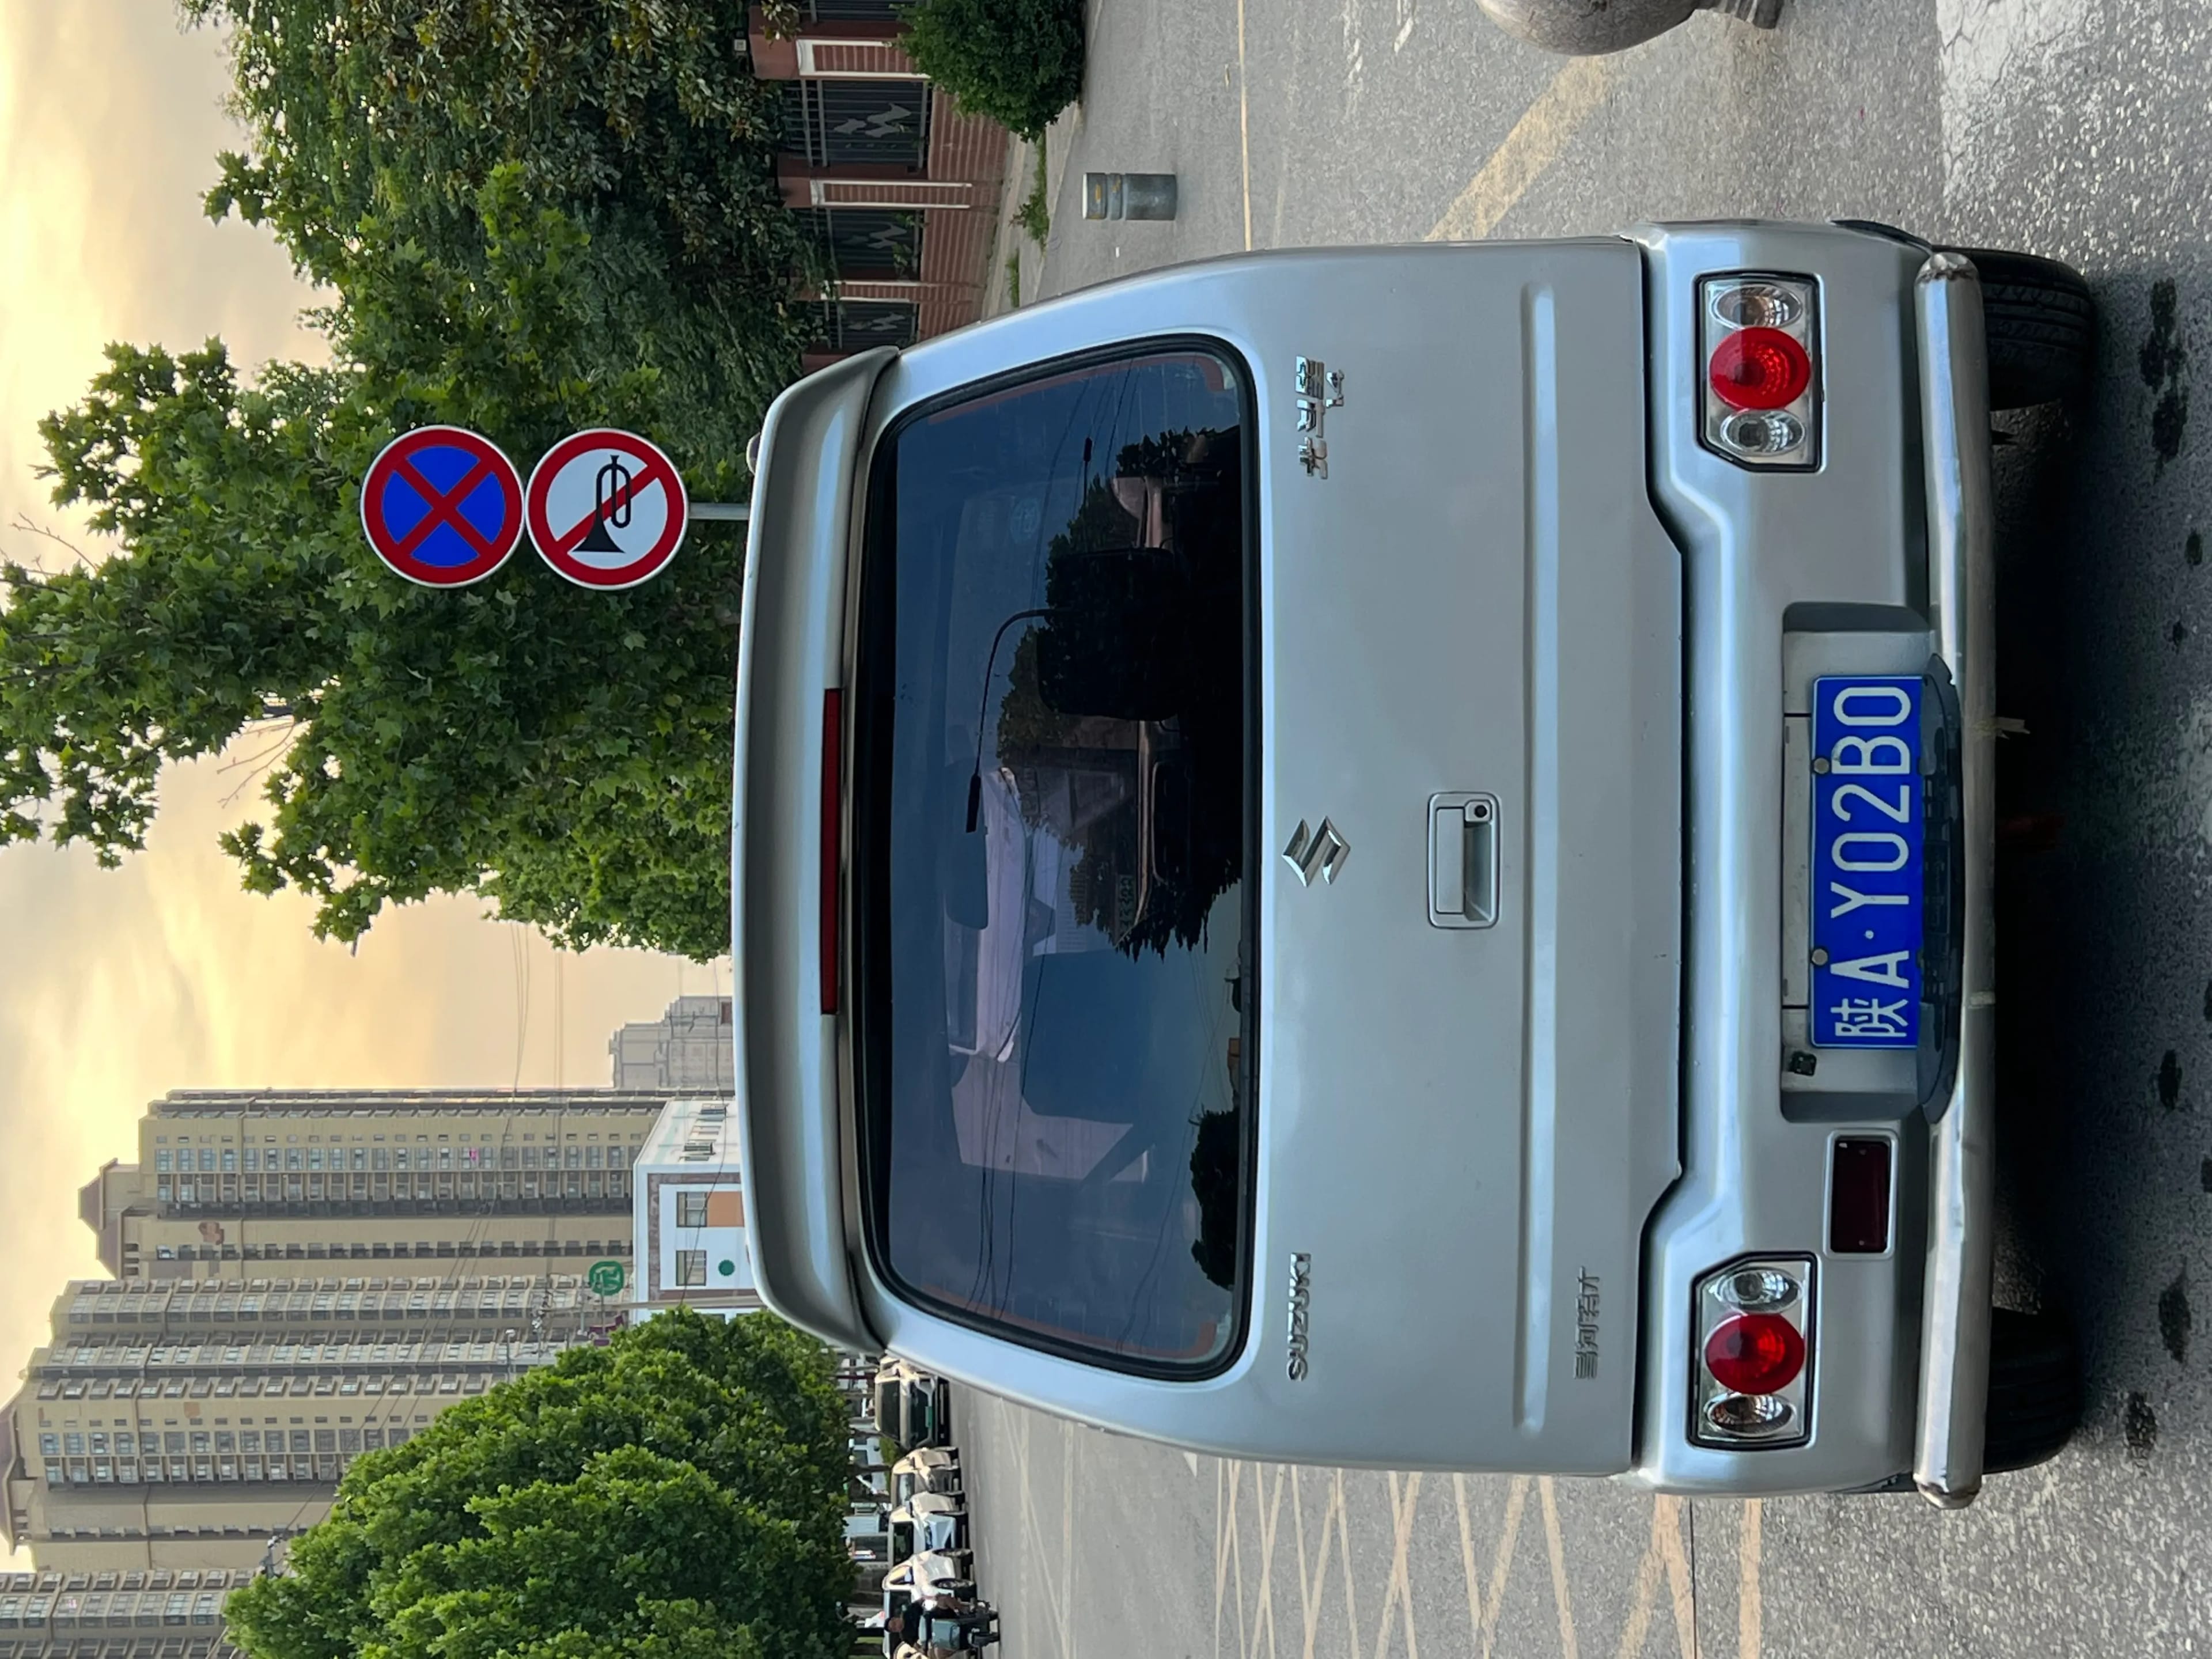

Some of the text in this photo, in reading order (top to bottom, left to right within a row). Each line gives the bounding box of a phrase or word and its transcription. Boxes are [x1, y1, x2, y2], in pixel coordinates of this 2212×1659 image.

[1296, 355, 1328, 479] 北斗星
[1286, 1252, 1310, 1381] SUZUKI
